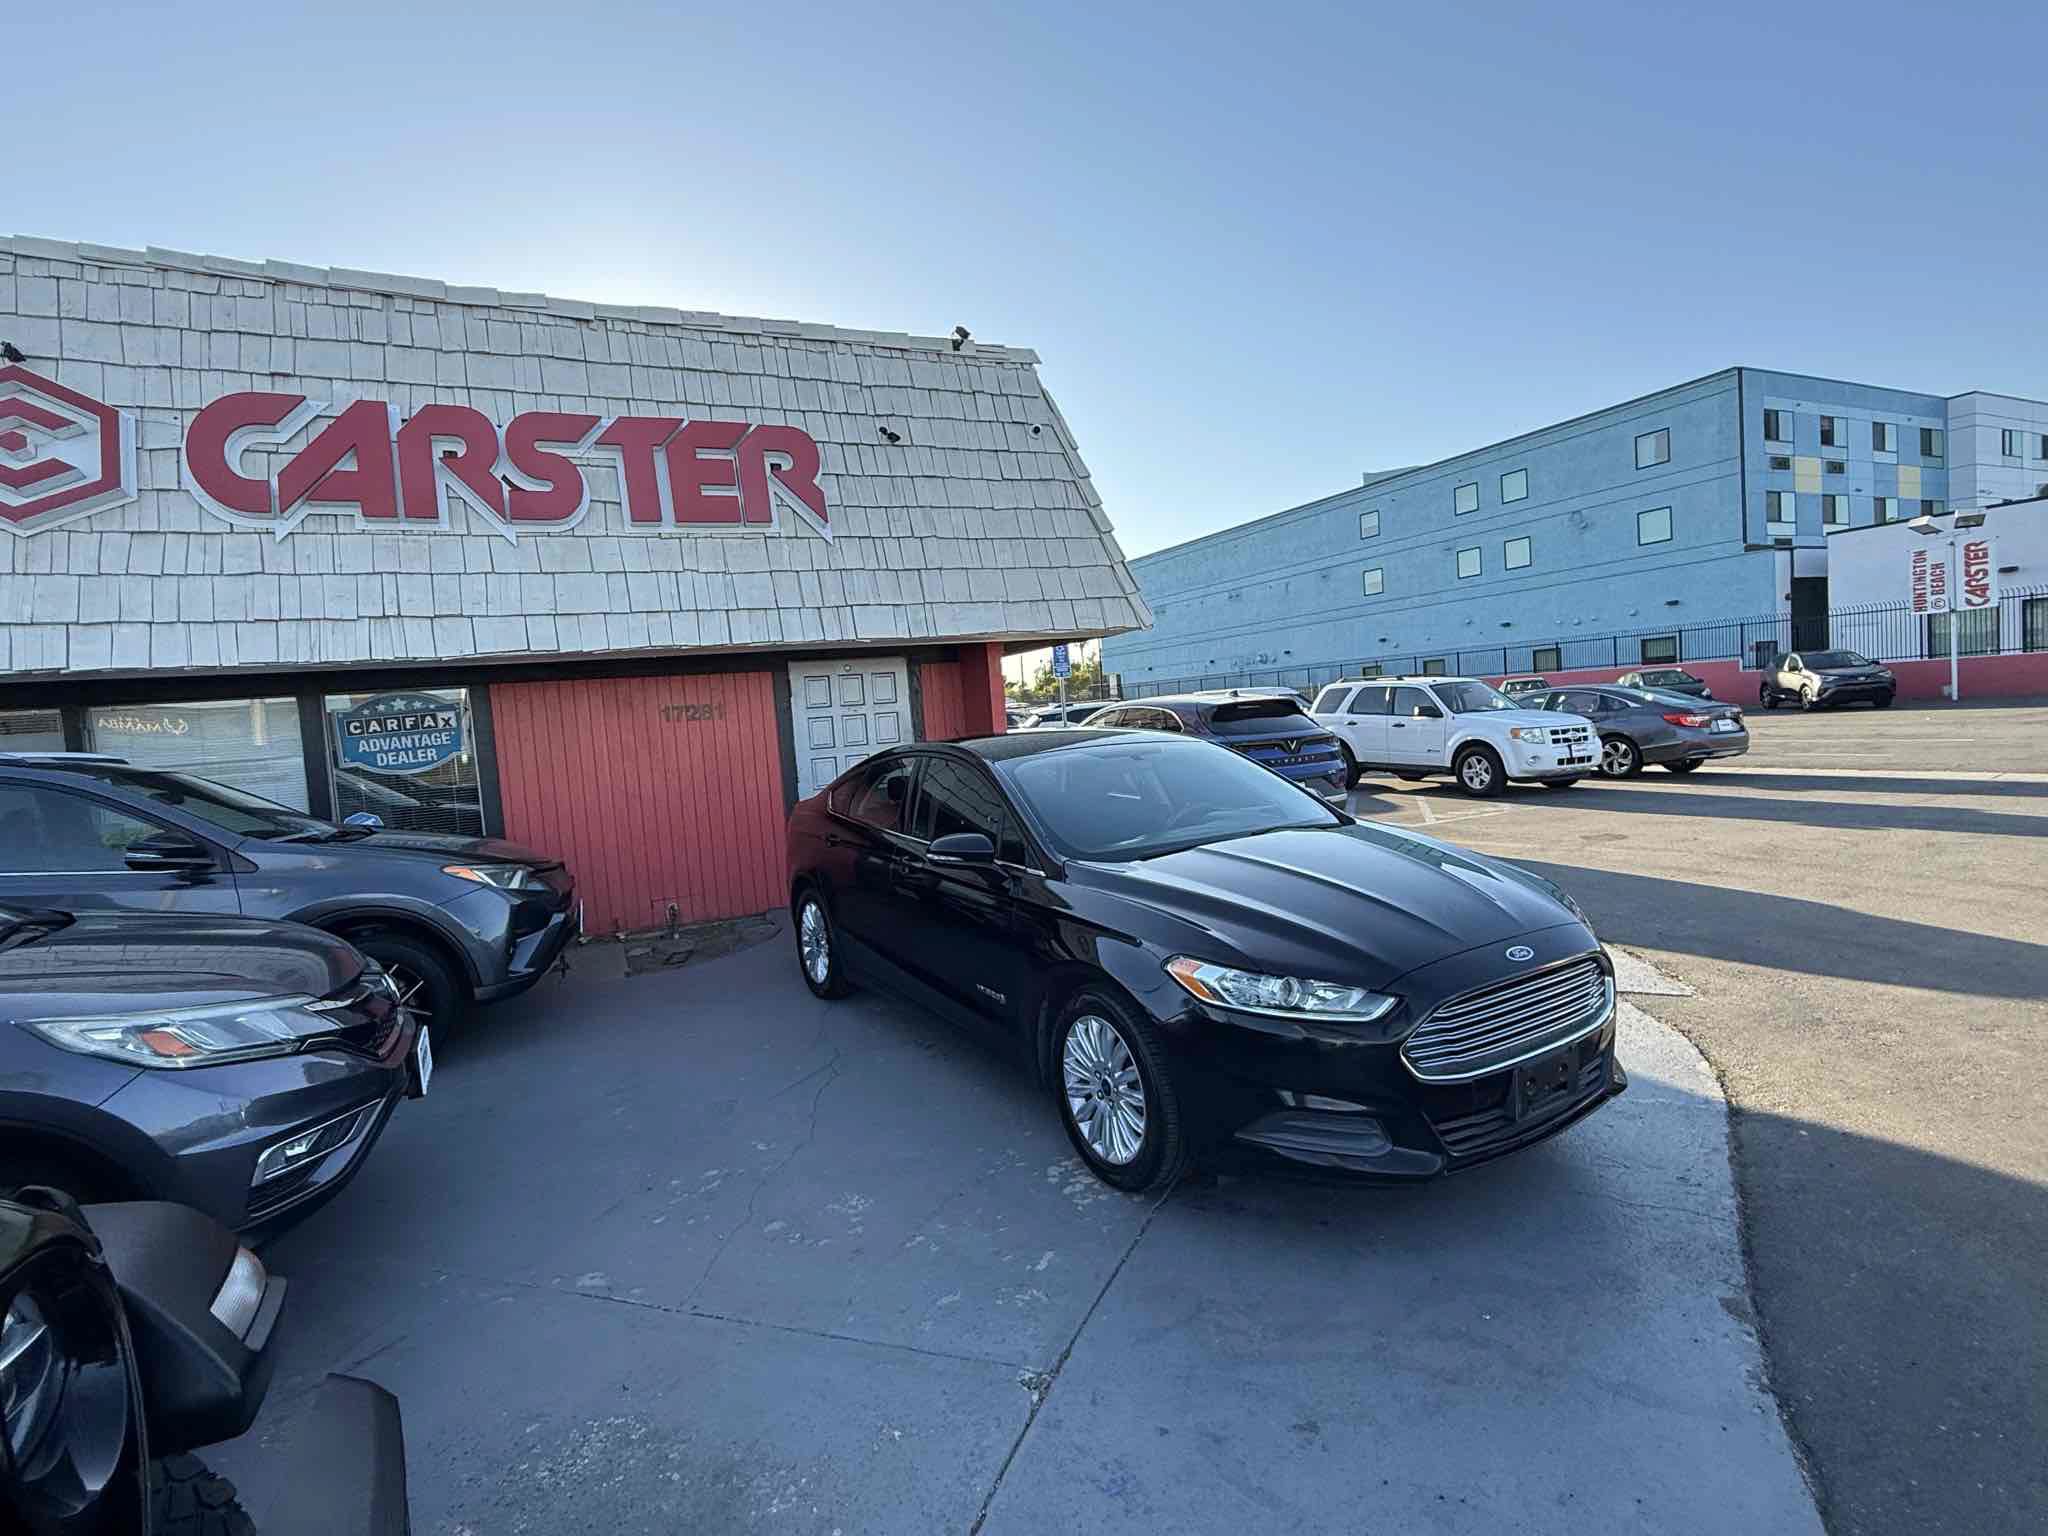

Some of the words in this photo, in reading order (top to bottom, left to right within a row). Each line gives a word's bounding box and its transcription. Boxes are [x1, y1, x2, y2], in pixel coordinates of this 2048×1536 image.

[186, 391, 830, 530] CARSTER
[1912, 549, 1927, 613] HUNTINGTON
[1930, 562, 1945, 596] BEACH
[1964, 540, 1990, 608] CARSTER
[347, 713, 455, 735] CARFAX
[358, 732, 452, 753] ADVANTAGE
[376, 748, 438, 767] DEALER
